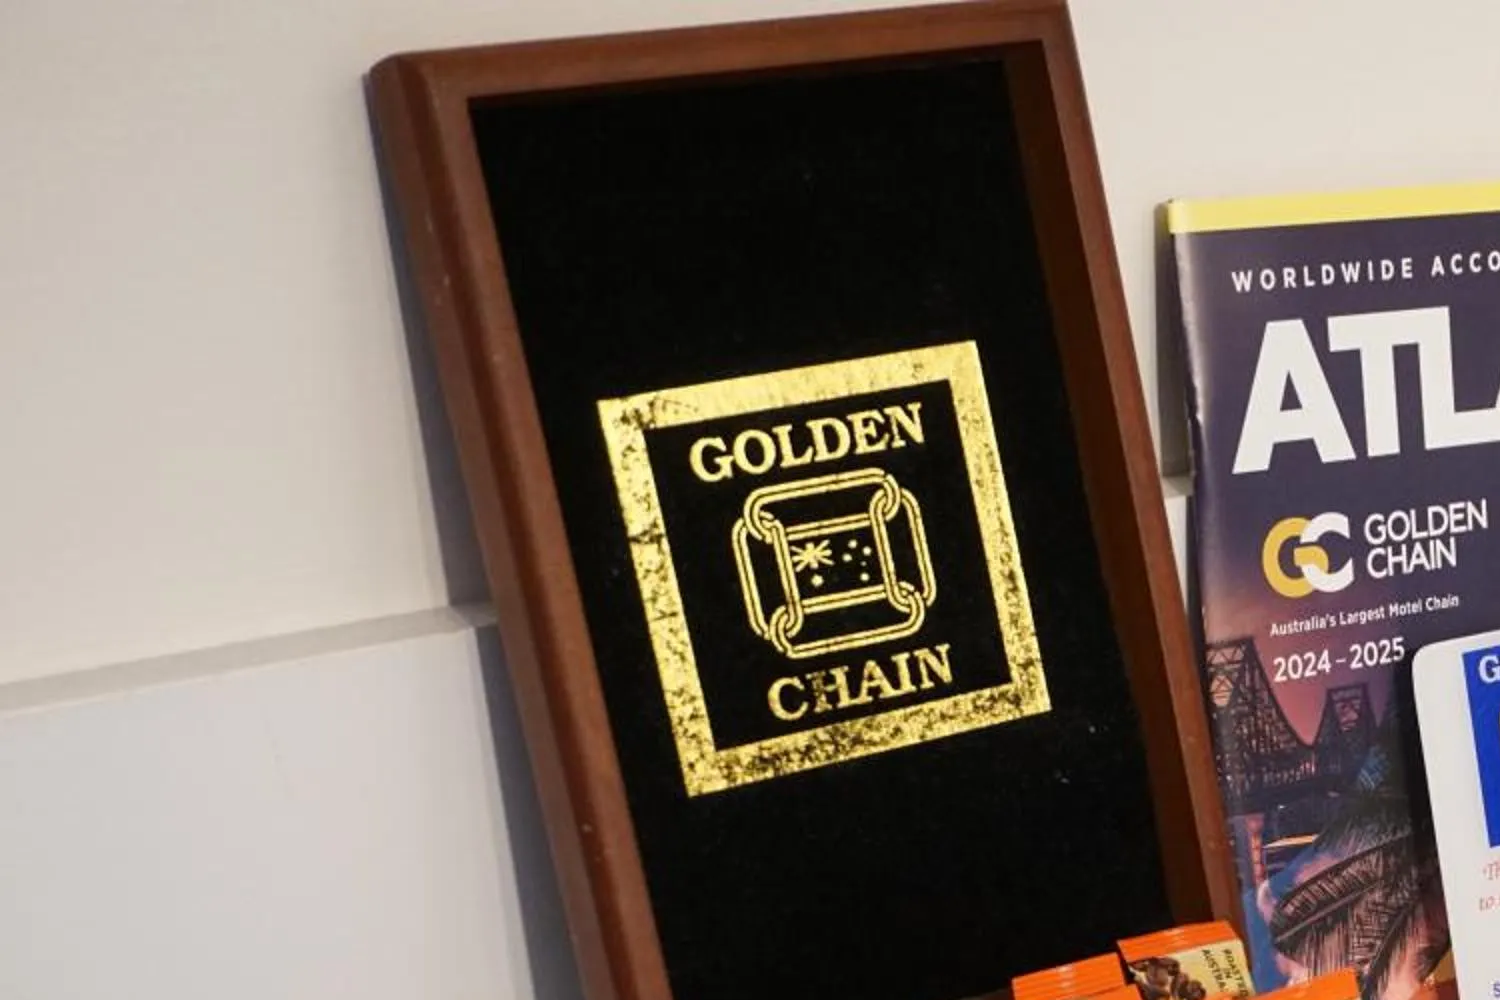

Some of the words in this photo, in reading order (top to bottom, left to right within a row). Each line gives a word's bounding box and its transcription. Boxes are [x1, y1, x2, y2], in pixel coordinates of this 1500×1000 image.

[1231, 257, 1413, 293] WORLDWIDE
[689, 402, 926, 483] GOLDEN
[1364, 497, 1488, 545] GOLDEN
[1366, 536, 1457, 579] CHAIN
[1270, 615, 1336, 637] Australia's
[1339, 607, 1385, 626] Largest
[1389, 600, 1422, 617] Motel
[1425, 593, 1459, 611] Chain
[767, 643, 953, 722] CHAIN
[1478, 896, 1495, 912] to
